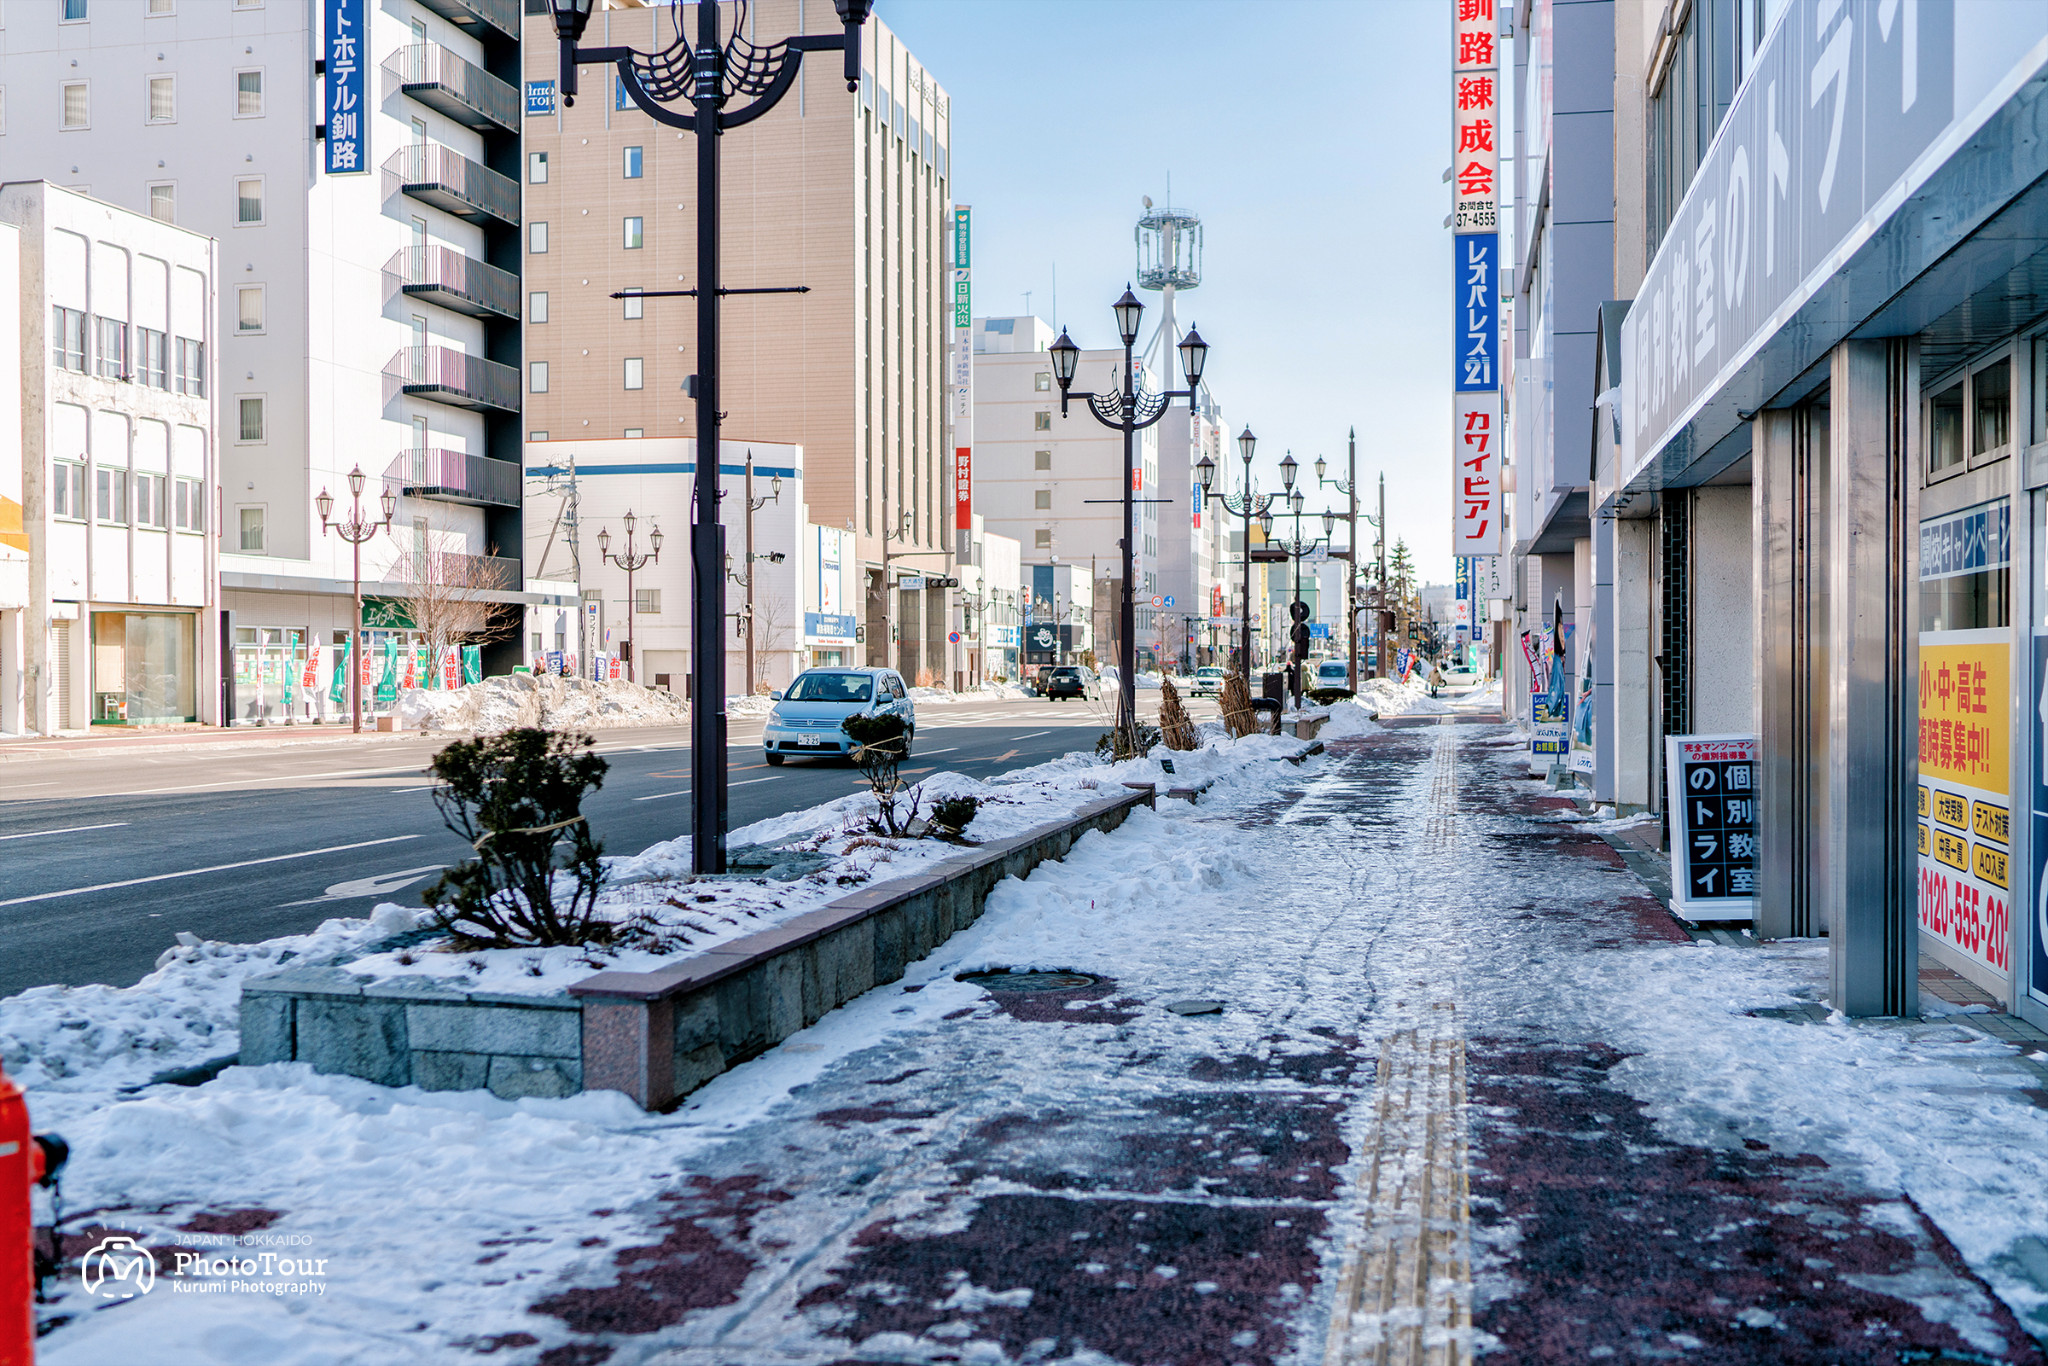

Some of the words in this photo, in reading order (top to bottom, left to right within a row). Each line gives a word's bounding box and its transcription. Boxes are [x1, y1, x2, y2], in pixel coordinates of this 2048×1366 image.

[1458, 0, 1494, 196] 釧路練成会
[1456, 212, 1496, 227] 37-4555
[1459, 201, 1493, 210] お問合せ
[957, 283, 969, 325] 日新火災
[1922, 520, 2010, 568] 開校キャンペーン
[1684, 741, 1753, 753] 完全マンツーマン
[1692, 751, 1747, 760] の個別指導塾
[1938, 796, 1964, 823] 大学受験
[1975, 808, 2009, 838] テスト対策
[1690, 767, 1719, 893] のトライ
[1725, 765, 1753, 892] 個別教室
[1938, 835, 1963, 864] 中高一貫
[1979, 852, 2006, 882] AO入試
